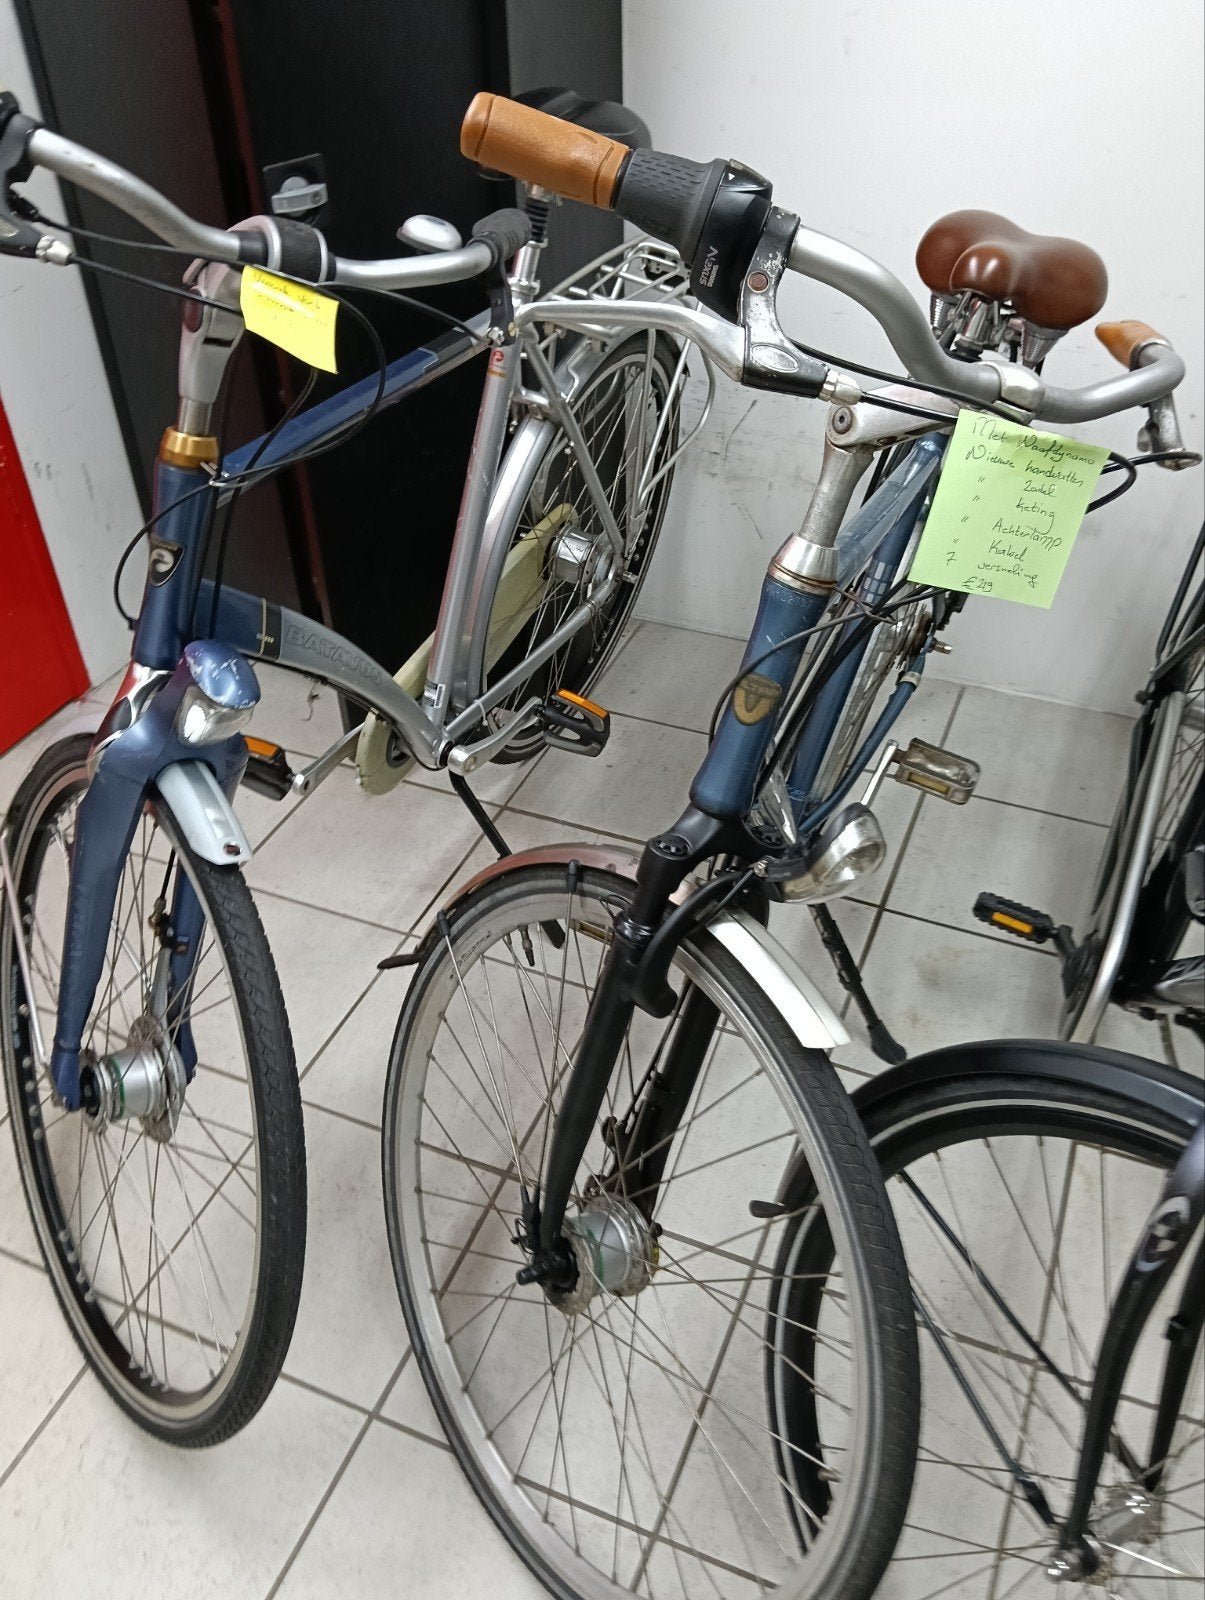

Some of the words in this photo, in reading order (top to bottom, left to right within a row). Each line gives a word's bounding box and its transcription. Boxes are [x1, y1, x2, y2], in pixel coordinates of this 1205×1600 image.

[972, 416, 1008, 443] Met
[1016, 434, 1095, 465] Naafdynamo
[965, 444, 1015, 468] Nieuwe
[991, 517, 1062, 552] Achterlamp
[946, 551, 957, 566] 7
